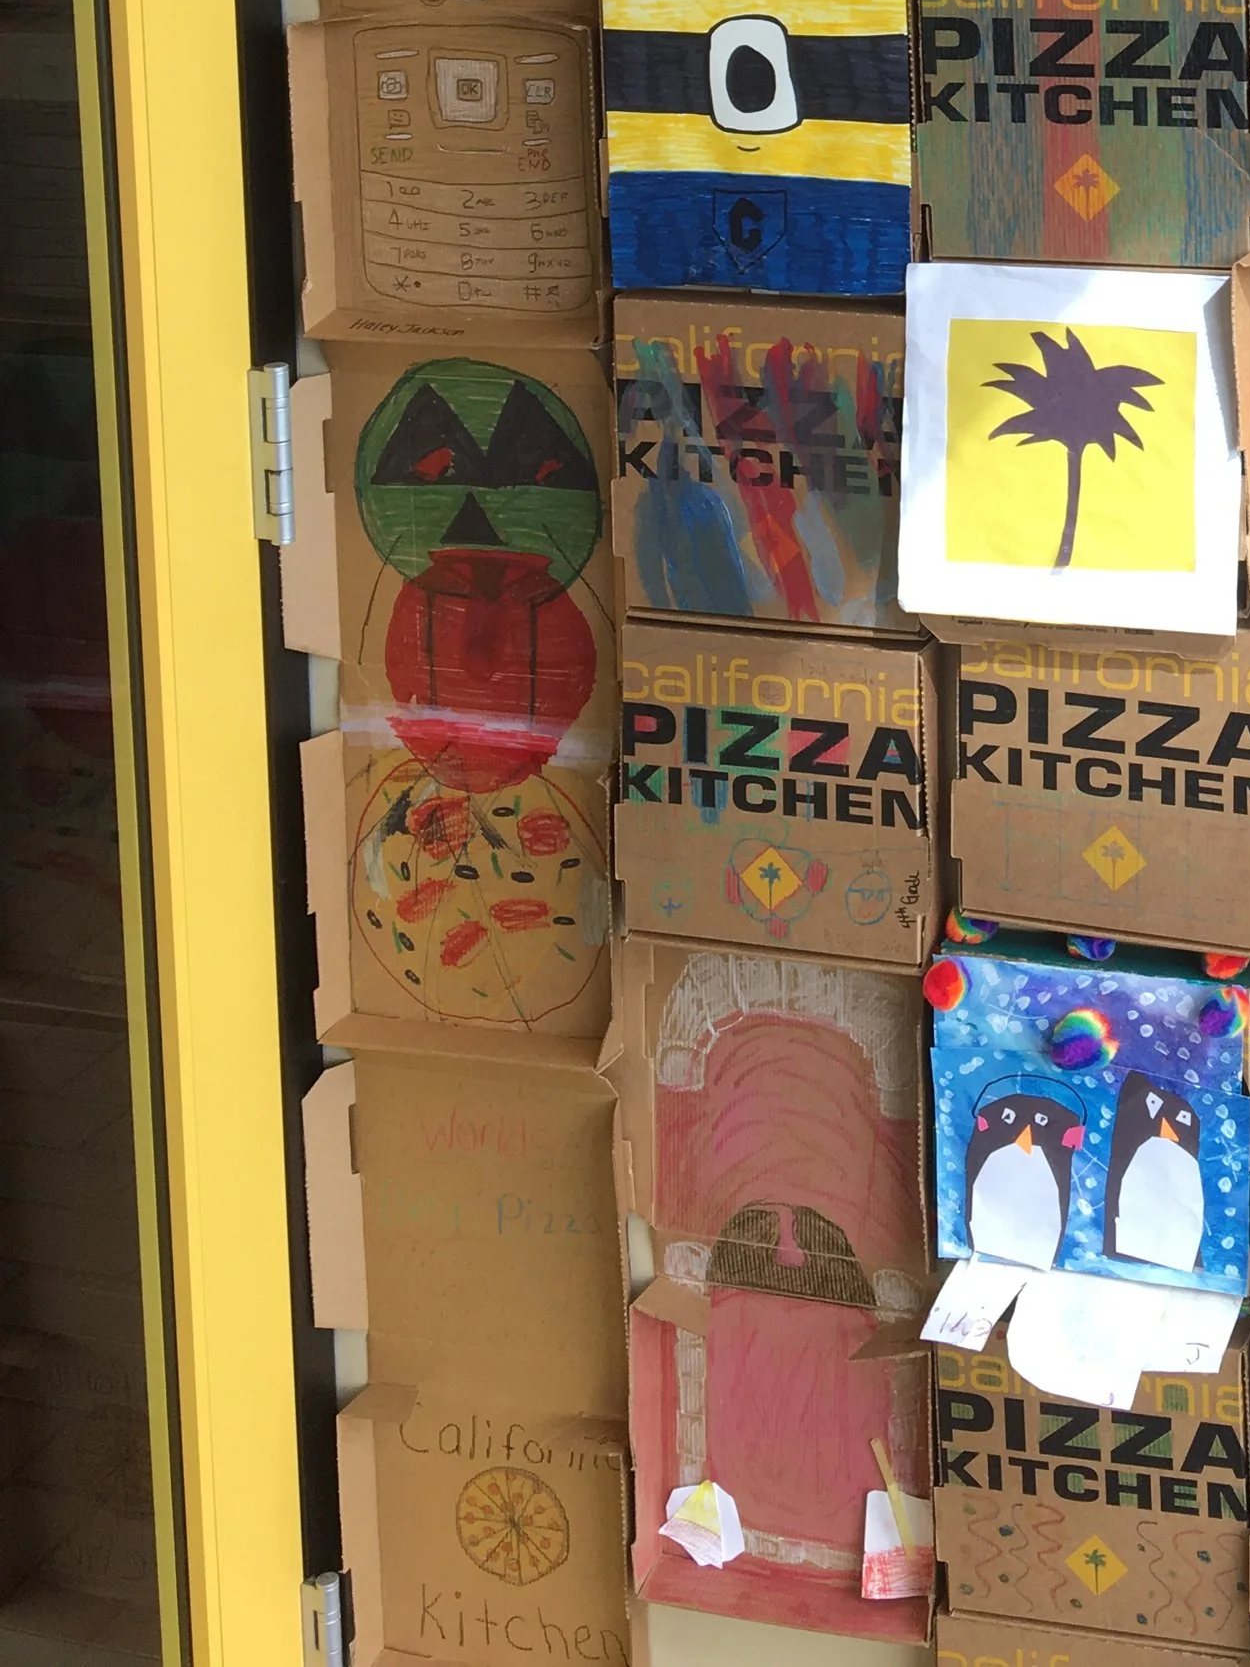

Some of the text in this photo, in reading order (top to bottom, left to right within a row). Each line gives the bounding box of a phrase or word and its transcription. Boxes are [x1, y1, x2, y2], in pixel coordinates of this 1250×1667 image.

[920, 16, 1247, 81] PIZZA
[922, 81, 1249, 131] KITCHEN
[370, 147, 413, 166] SEND
[516, 157, 552, 173] END
[623, 652, 920, 727] california
[624, 701, 922, 785] PIZZA
[622, 763, 924, 831] KITCHEN
[938, 1349, 1242, 1424] calnia
[937, 1391, 1245, 1481] PIZZA
[937, 1447, 1249, 1522] KITCHEN
